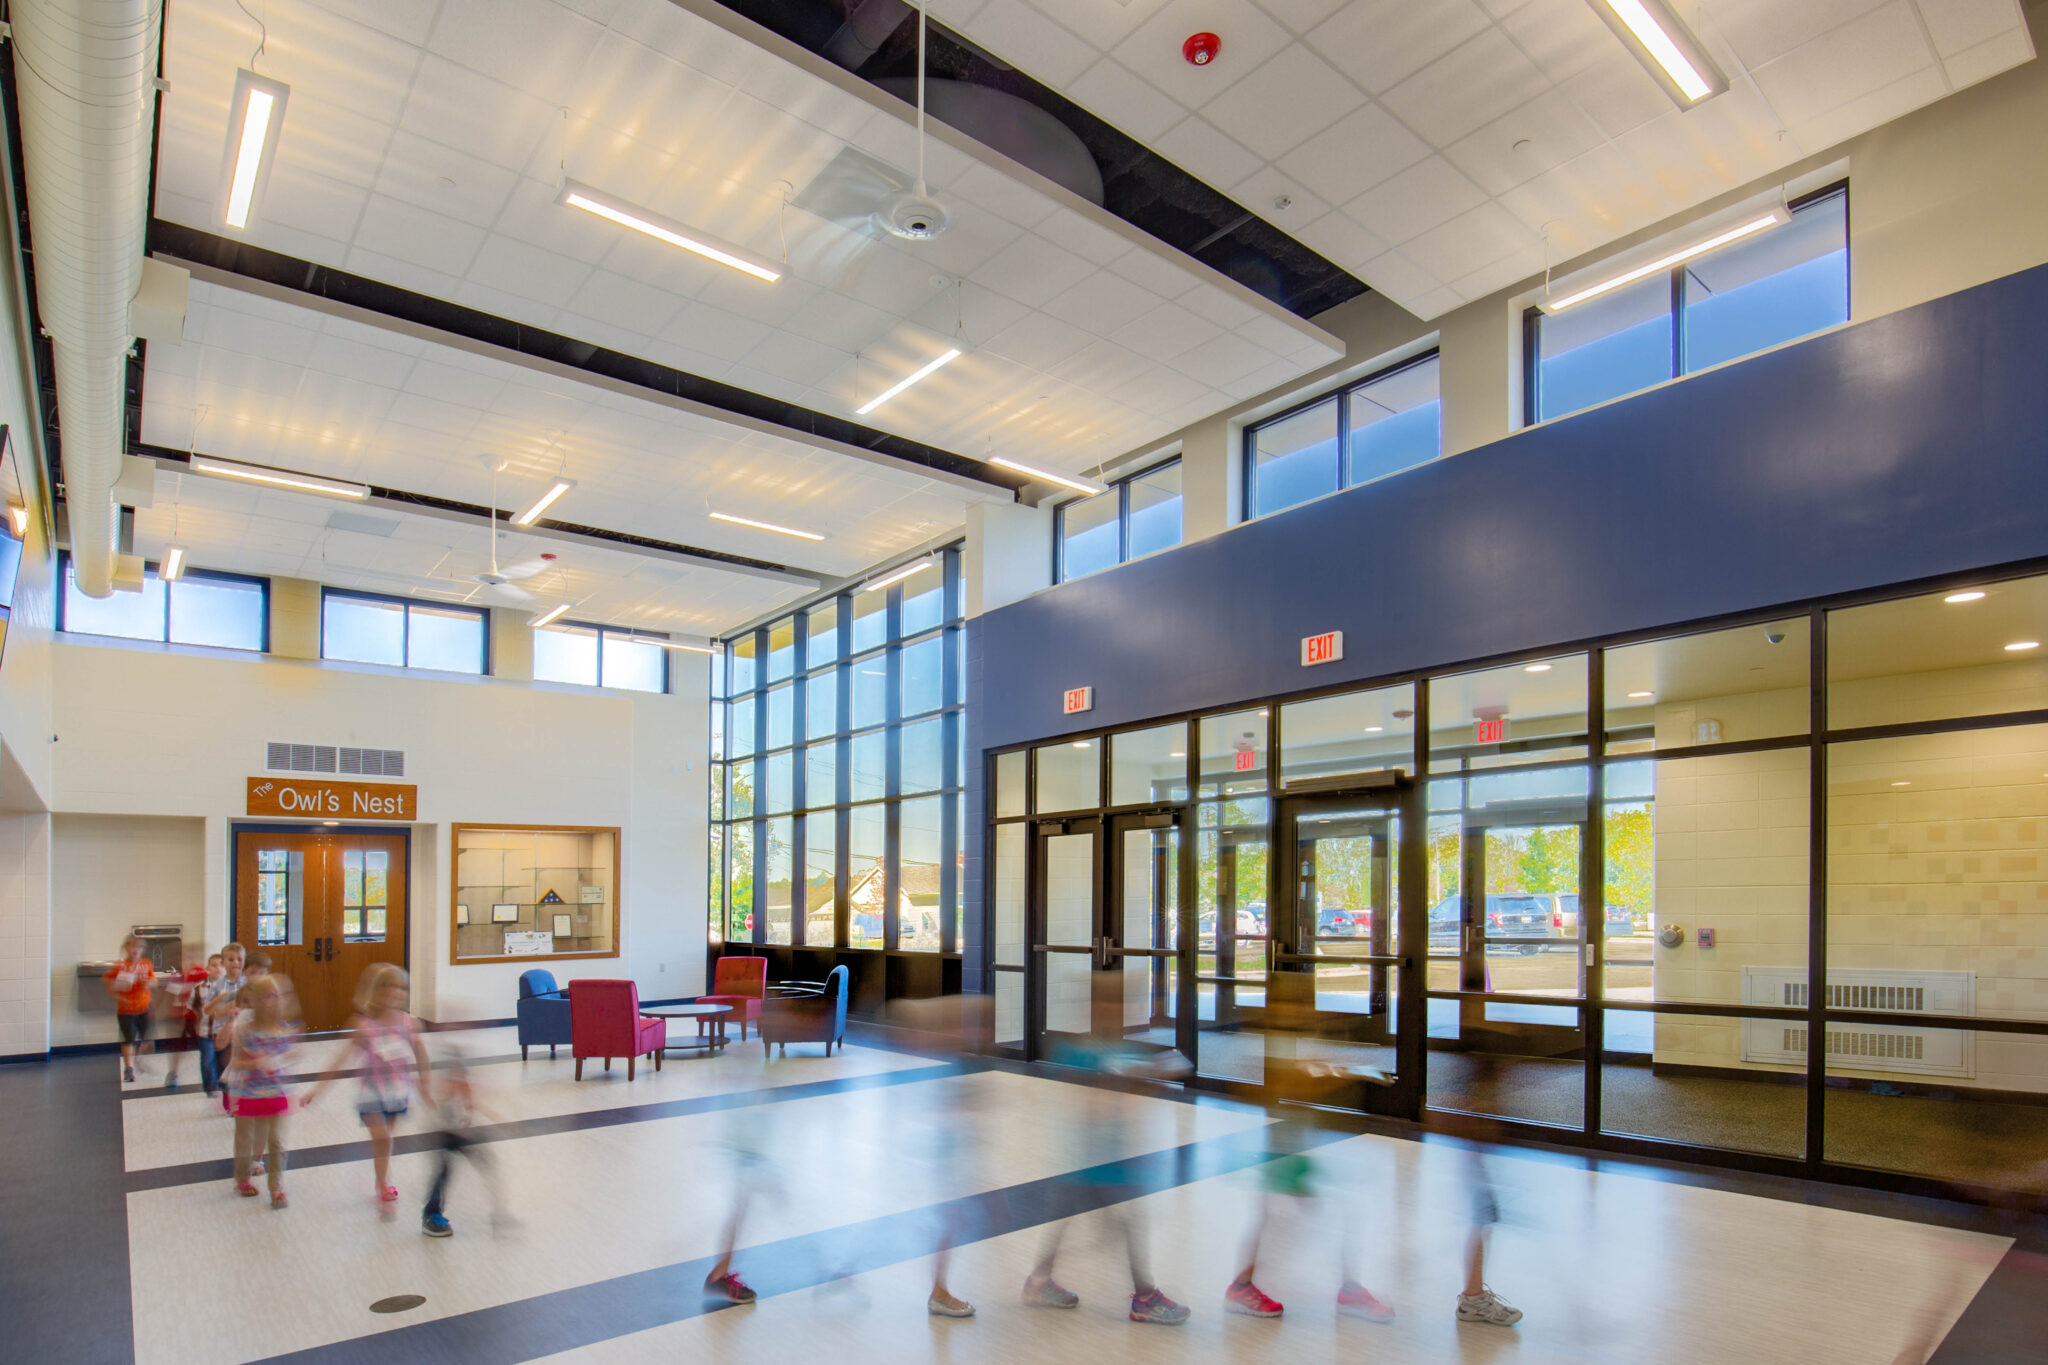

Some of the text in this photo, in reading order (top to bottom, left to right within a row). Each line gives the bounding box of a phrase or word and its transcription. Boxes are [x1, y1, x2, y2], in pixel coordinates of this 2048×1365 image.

[1308, 633, 1335, 663] EXIT
[1068, 688, 1086, 711] EXIT
[1478, 719, 1504, 743] EXIT
[1236, 751, 1256, 770] EXIT
[252, 782, 404, 814] The Owl's Nest
